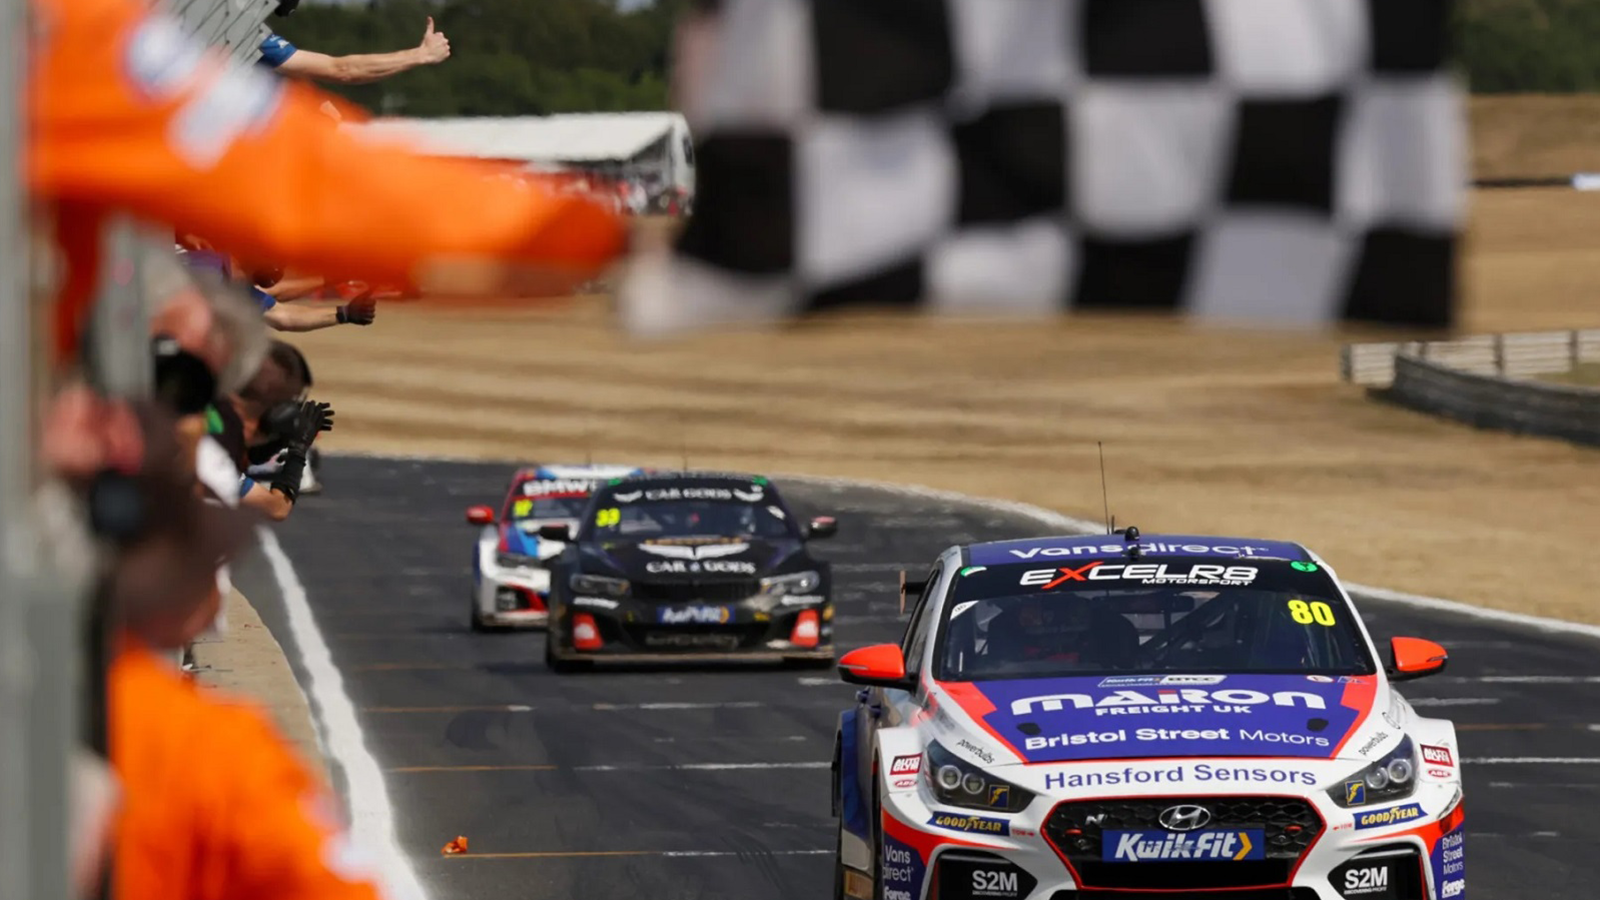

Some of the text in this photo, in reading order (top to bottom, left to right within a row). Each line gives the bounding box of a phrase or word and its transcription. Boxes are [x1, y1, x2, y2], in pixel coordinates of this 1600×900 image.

[1019, 561, 1258, 589] EXCELR8
[1142, 578, 1252, 586] MOTORSPORT
[1288, 600, 1336, 626] 80
[1095, 704, 1252, 716] FREIGHT UK
[1025, 728, 1330, 750] Bristol Street Motors
[1045, 764, 1317, 790] Hansford Sensors
[936, 816, 1002, 831] GOODYEAR
[1361, 807, 1419, 825] GOODYEAR
[885, 845, 910, 864] Vans
[1114, 832, 1237, 861] KwikFit
[1443, 846, 1463, 862] Street
[972, 870, 1018, 891] S2M
[1344, 866, 1388, 889] S2M
